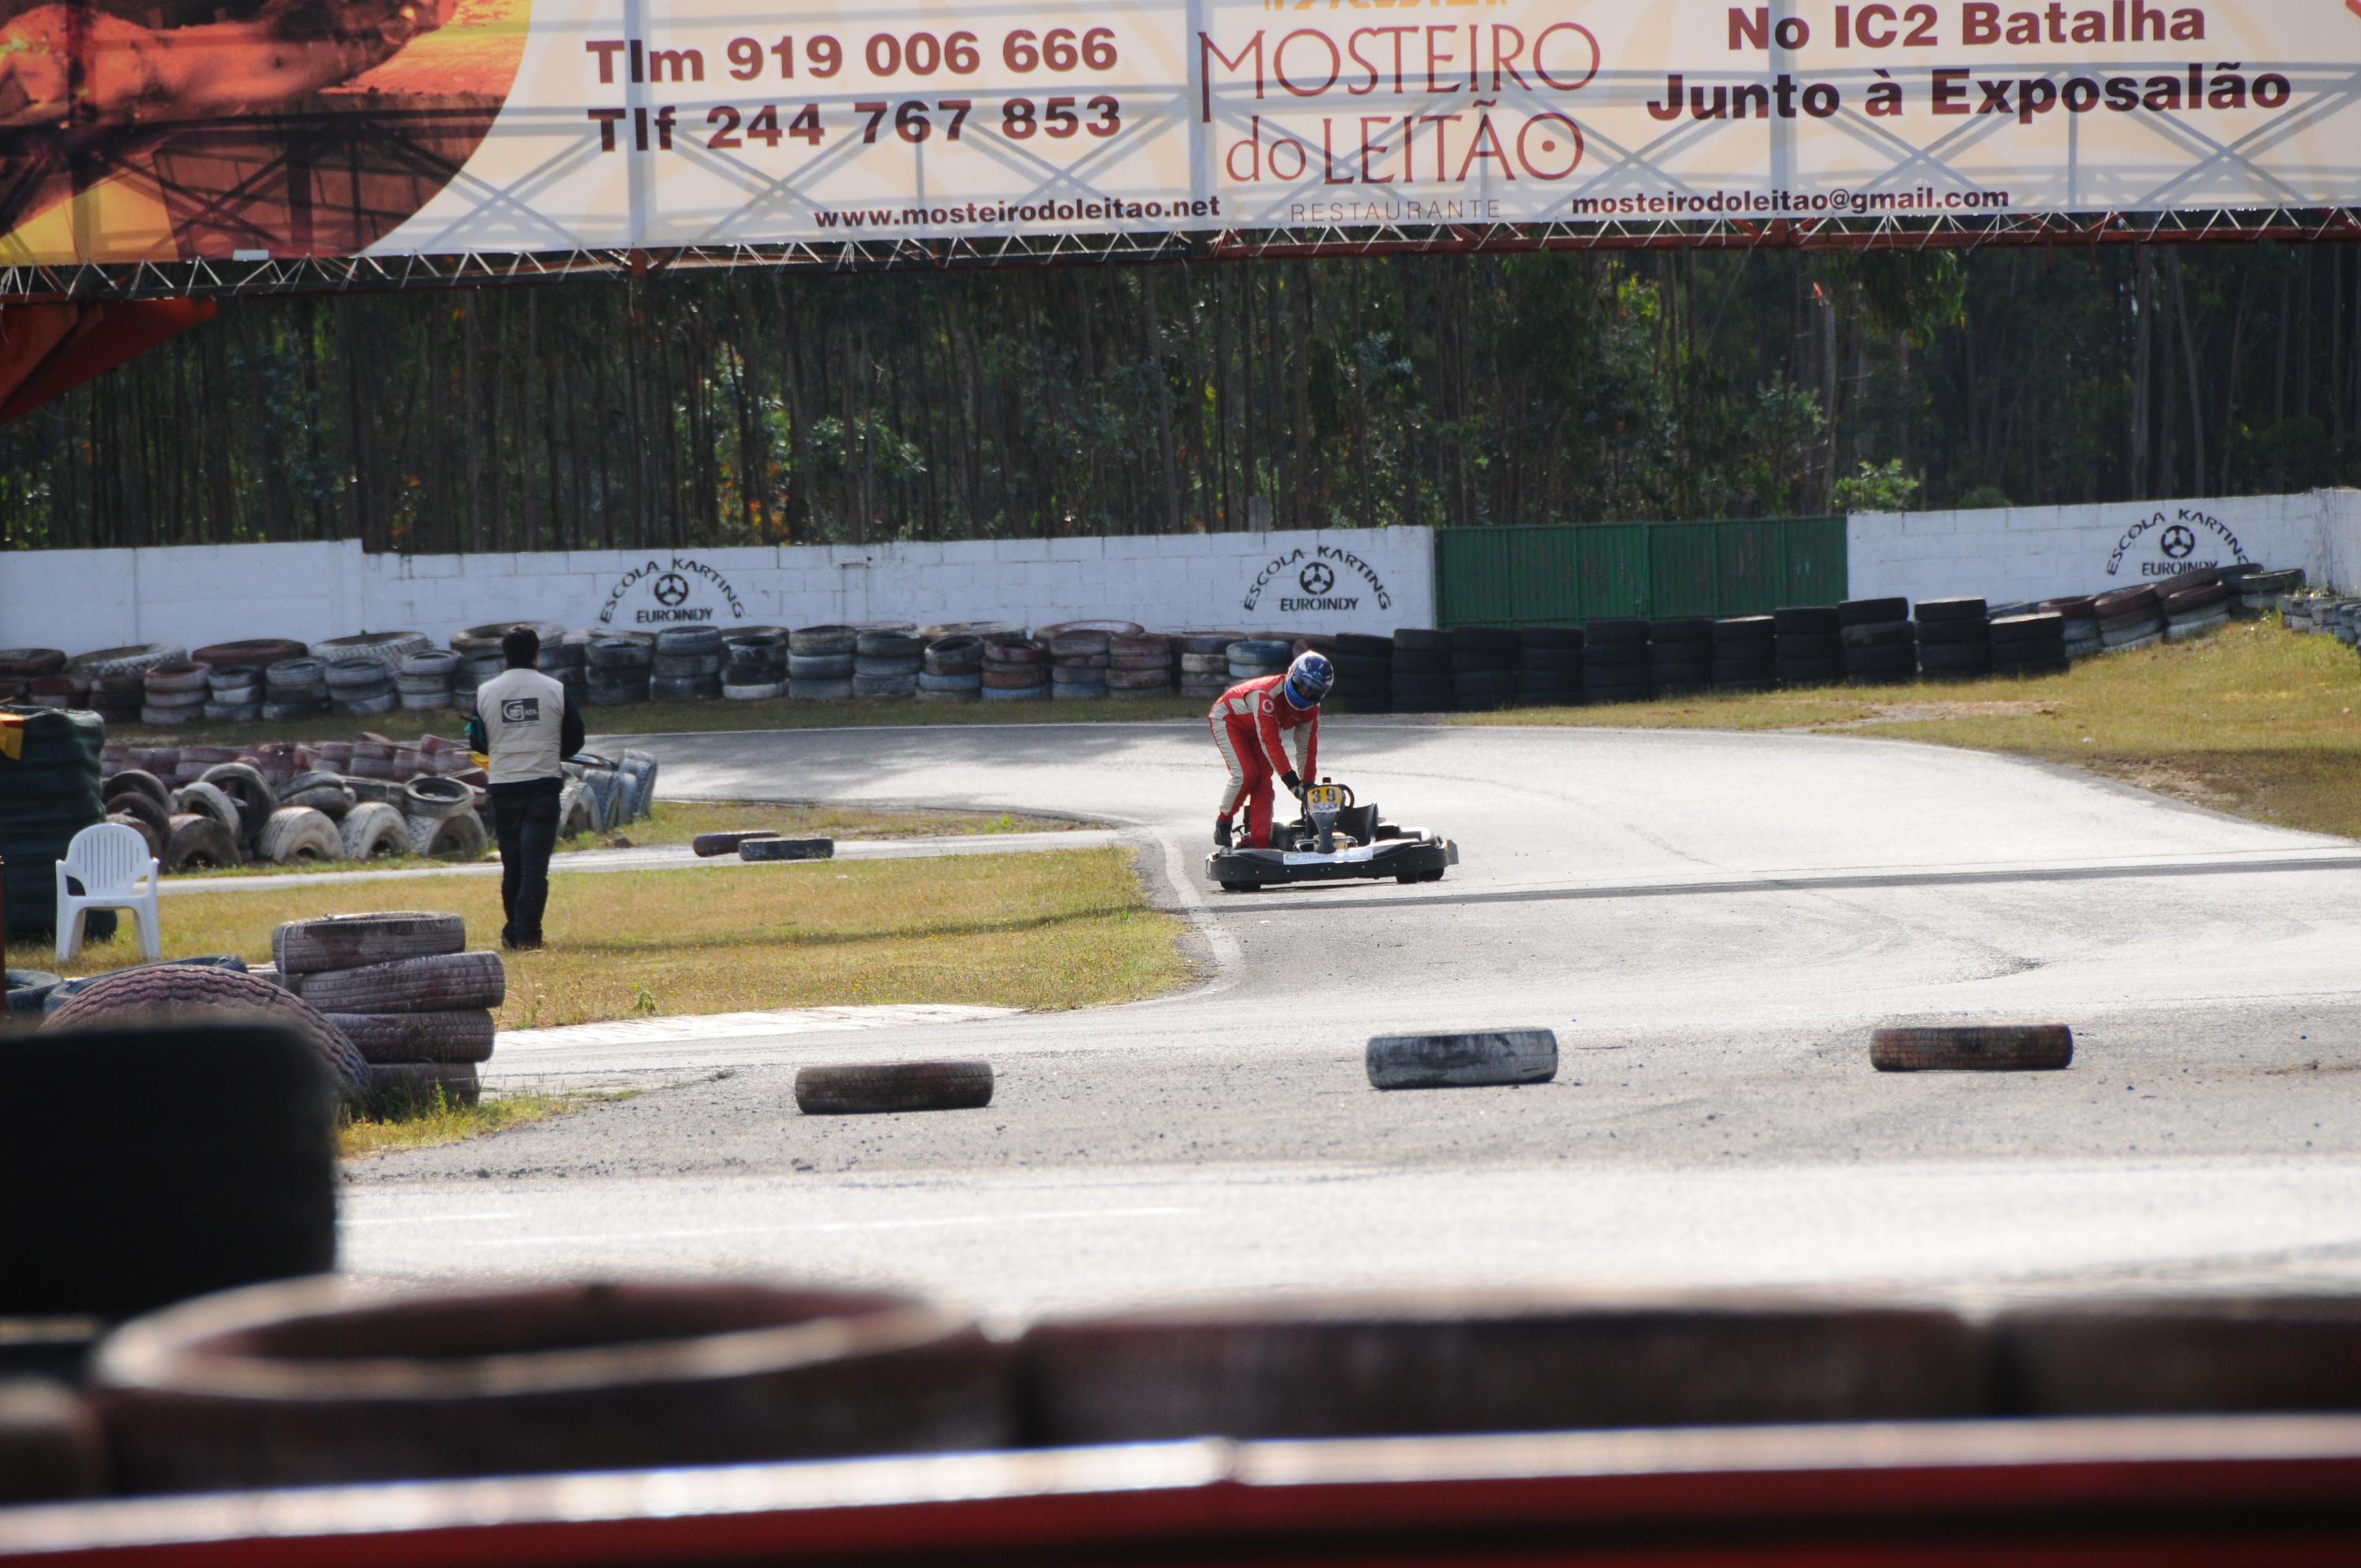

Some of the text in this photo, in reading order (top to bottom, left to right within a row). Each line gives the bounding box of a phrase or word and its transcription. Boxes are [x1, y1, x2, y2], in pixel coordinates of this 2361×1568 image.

[1728, 0, 2205, 50] No IC2 Batalha
[586, 28, 1117, 83] Tlm 919 006 666
[1197, 22, 1600, 122] MOSTEIRO
[1647, 62, 2292, 124] Junto à Exposalão
[588, 95, 1121, 152] Tlf 244 767 853
[1227, 98, 1584, 185] do LEITÃO
[814, 195, 1220, 228] www.mosteirodoleitao.net
[1290, 198, 1501, 223] RESTAURANTE
[1572, 186, 2009, 215] mosteirodoleitao@gmail.com
[2106, 512, 2166, 576] ESCOLA
[599, 559, 746, 623] ESCOLA KARTING
[1243, 546, 1392, 612] ESCOLA KARTING
[1280, 598, 1359, 611] EUROINDY
[636, 608, 713, 623] EUROINDY
[1311, 788, 1336, 803] 39
